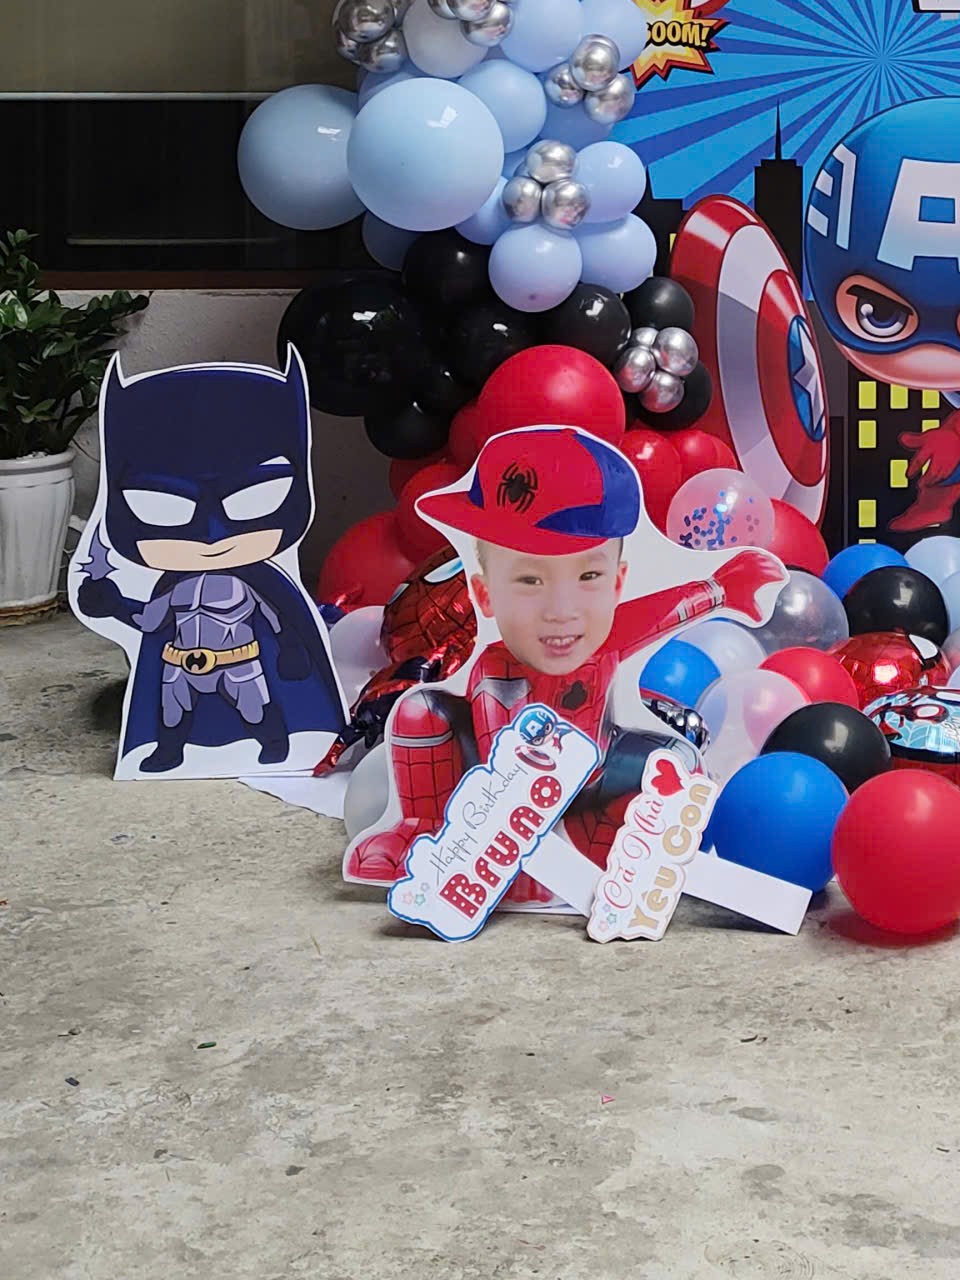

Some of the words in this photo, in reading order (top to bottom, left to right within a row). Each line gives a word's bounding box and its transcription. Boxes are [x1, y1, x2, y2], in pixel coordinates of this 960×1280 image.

[645, 20, 711, 48] OOM!
[429, 831, 478, 886] Happy
[462, 763, 529, 830] Birthday
[438, 774, 563, 920] Bruno
[662, 783, 713, 857] Con
